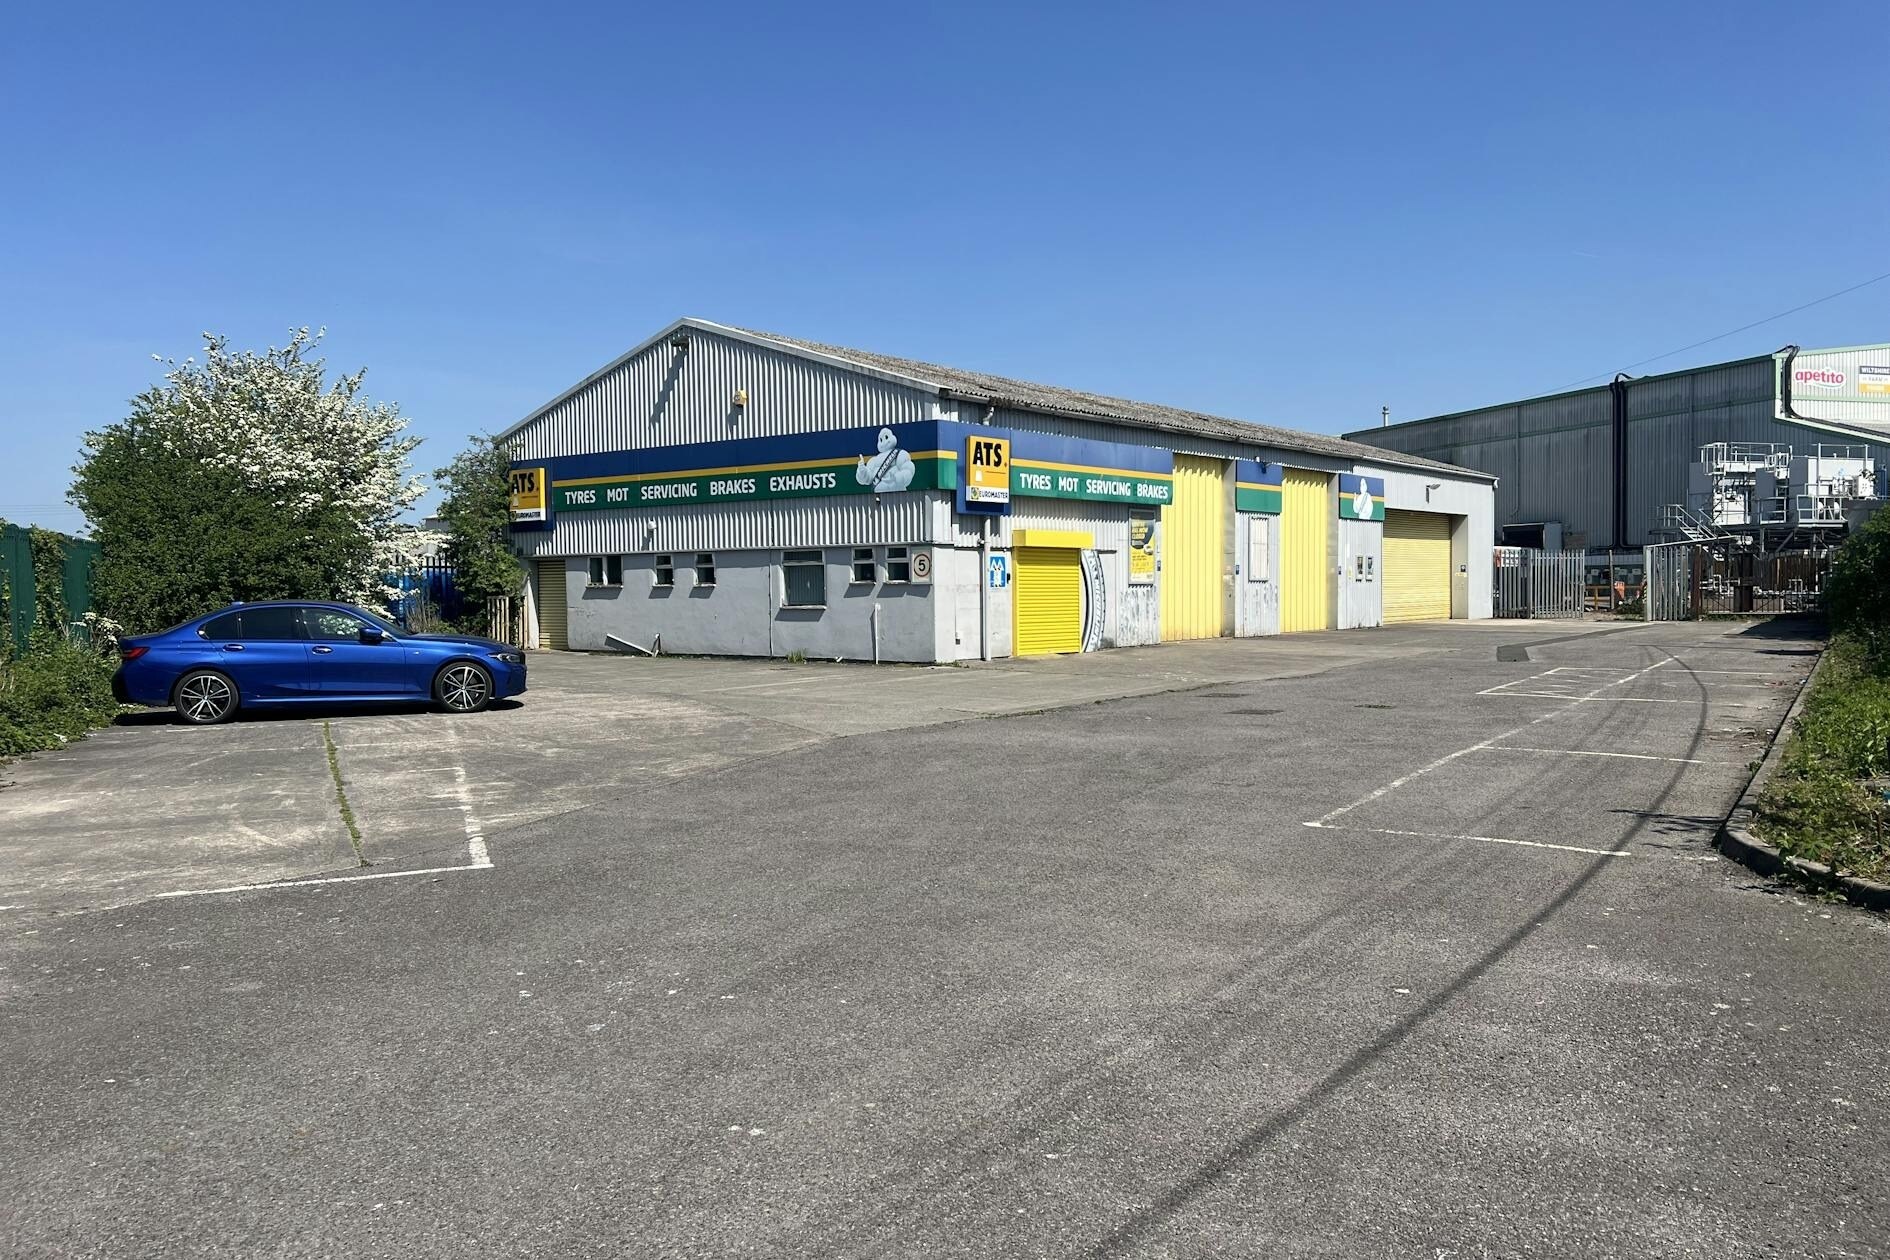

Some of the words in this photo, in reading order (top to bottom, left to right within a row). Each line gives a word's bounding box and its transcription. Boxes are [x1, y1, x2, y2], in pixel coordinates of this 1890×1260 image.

[1795, 369, 1844, 383] apetito
[973, 441, 1002, 467] ATS
[511, 472, 535, 493] ATS
[565, 490, 596, 505] TYRES
[607, 488, 629, 502] MOT
[641, 483, 697, 500] SERVICING
[710, 479, 755, 496] BRAKES
[770, 473, 836, 491] EXHAUSTS
[1020, 473, 1051, 490] TYRES
[1059, 477, 1079, 492] MOT
[1086, 479, 1131, 497] SERVICING
[1137, 483, 1168, 499] BRAKES
[979, 491, 1008, 499] EUROMASTER
[918, 559, 926, 571] 5
